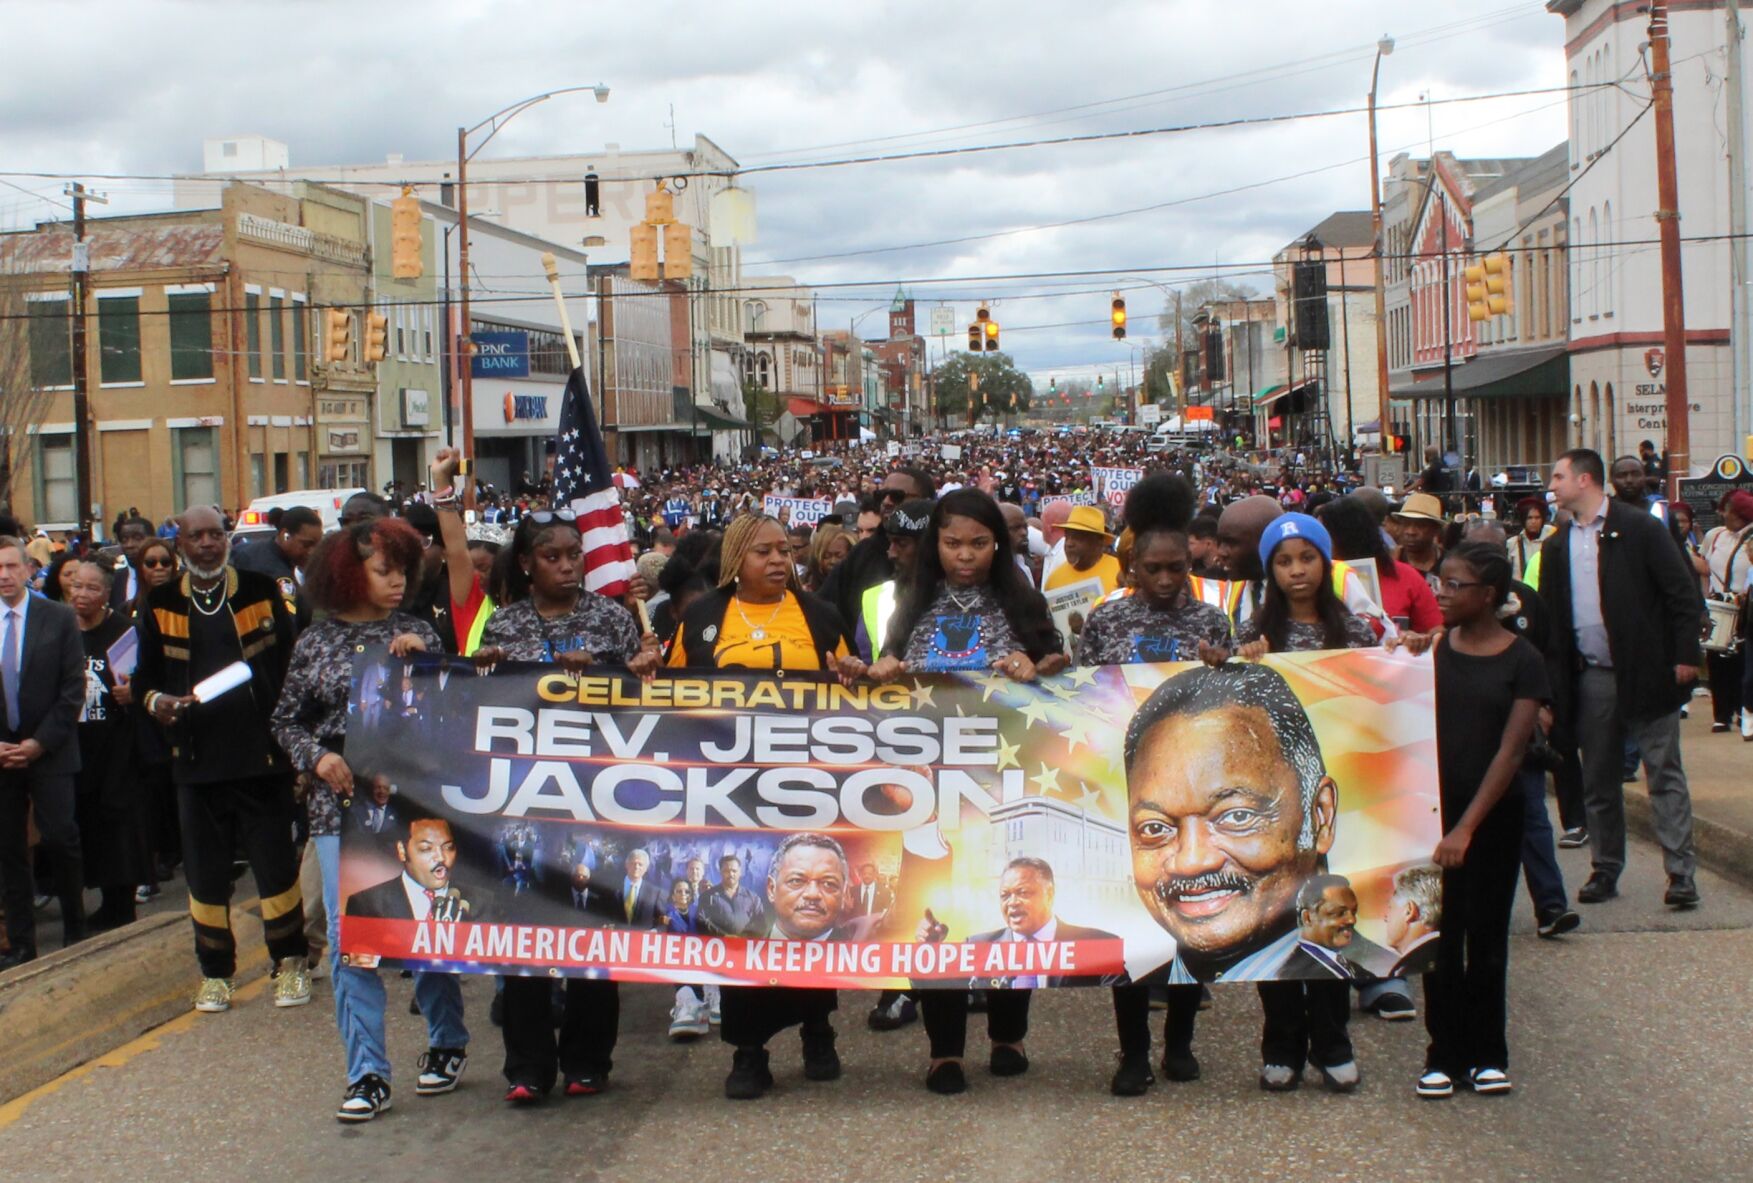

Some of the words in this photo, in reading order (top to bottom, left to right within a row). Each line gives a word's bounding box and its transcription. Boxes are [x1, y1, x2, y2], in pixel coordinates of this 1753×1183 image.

[481, 343, 511, 354] PNC
[482, 357, 520, 369] BANK
[1638, 418, 1668, 429] Cent
[1092, 468, 1141, 480] PROTECT
[766, 497, 830, 512] PROTECT
[537, 673, 911, 711] CELEBRATING
[474, 705, 669, 762] REV.
[700, 715, 998, 766] JESSE
[441, 757, 1025, 832] JACKSON
[411, 922, 456, 955] AN
[464, 925, 630, 963] AMERICAN
[640, 934, 734, 969] HERO.
[745, 940, 880, 974] KEEPING
[891, 943, 975, 974] HOPE
[984, 941, 1076, 972] ALIVE
